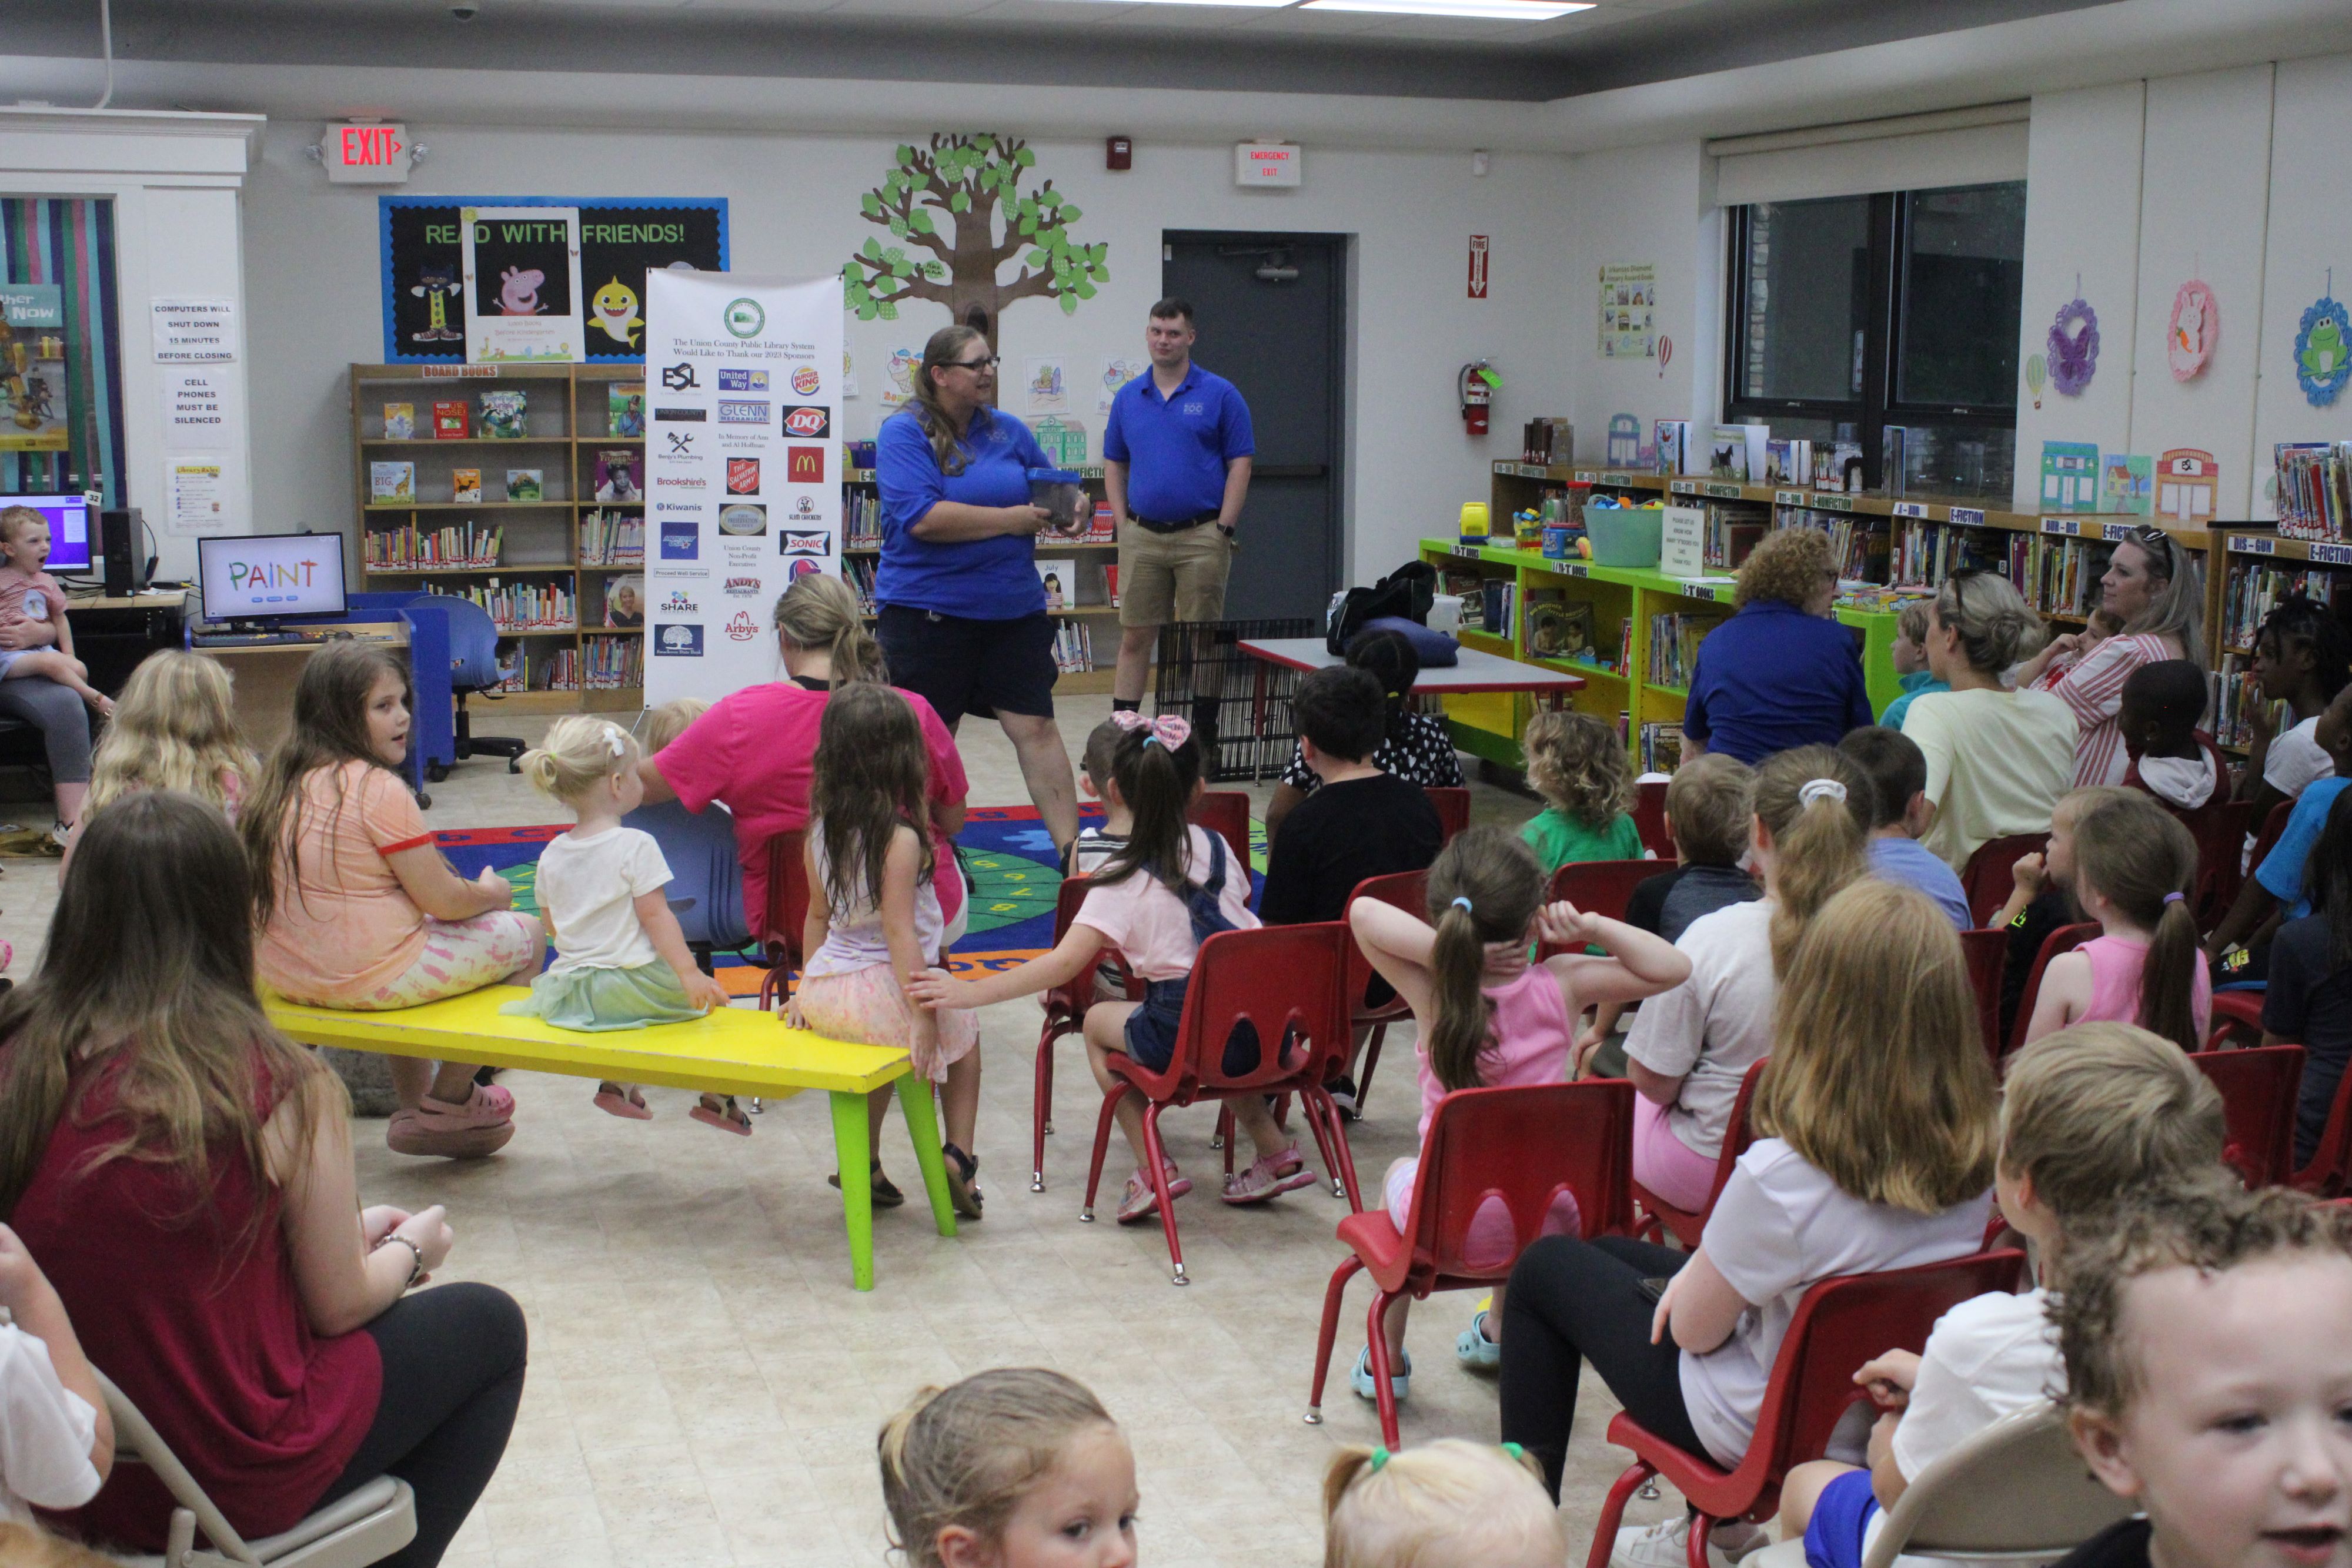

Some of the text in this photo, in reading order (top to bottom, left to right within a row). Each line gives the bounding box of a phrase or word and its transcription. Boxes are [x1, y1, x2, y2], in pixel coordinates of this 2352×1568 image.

[340, 128, 395, 165] EXIT
[1251, 151, 1289, 160] EMERGENCY
[1262, 168, 1277, 176] EXIT
[502, 223, 566, 243] WITH
[582, 224, 684, 243] FRIENDS!
[1472, 241, 1485, 249] FIRE
[714, 340, 739, 349] County
[764, 341, 789, 349] Library
[791, 342, 815, 350] System
[784, 352, 815, 360] Sponsors
[424, 366, 496, 377] BOARD BOOKS
[663, 362, 700, 392] ESL
[720, 371, 747, 379] United
[794, 371, 818, 382] BURGER
[730, 380, 747, 390] Way
[795, 376, 819, 389] KING
[720, 404, 767, 416] GLENN
[792, 414, 820, 430] DQ
[733, 463, 746, 473] THE
[729, 464, 757, 486] SALVATION
[657, 477, 706, 486] Brookshire's
[739, 474, 756, 490] ARMY
[1705, 483, 1740, 498] E-NONFICTION
[1812, 494, 1852, 511] E-NONFICTION
[1950, 509, 1984, 525] E-FICTION
[790, 540, 822, 548] SONIC
[2234, 537, 2272, 553] DIS GUN
[1466, 547, 1479, 559] BOOKS
[2310, 544, 2352, 564] E-FICTIO
[229, 559, 319, 591] PAINT
[1572, 565, 1587, 577] BOOKS
[724, 577, 761, 589] ANDY'S
[1696, 586, 1714, 600] BOOKS
[724, 624, 759, 635] Arby's
